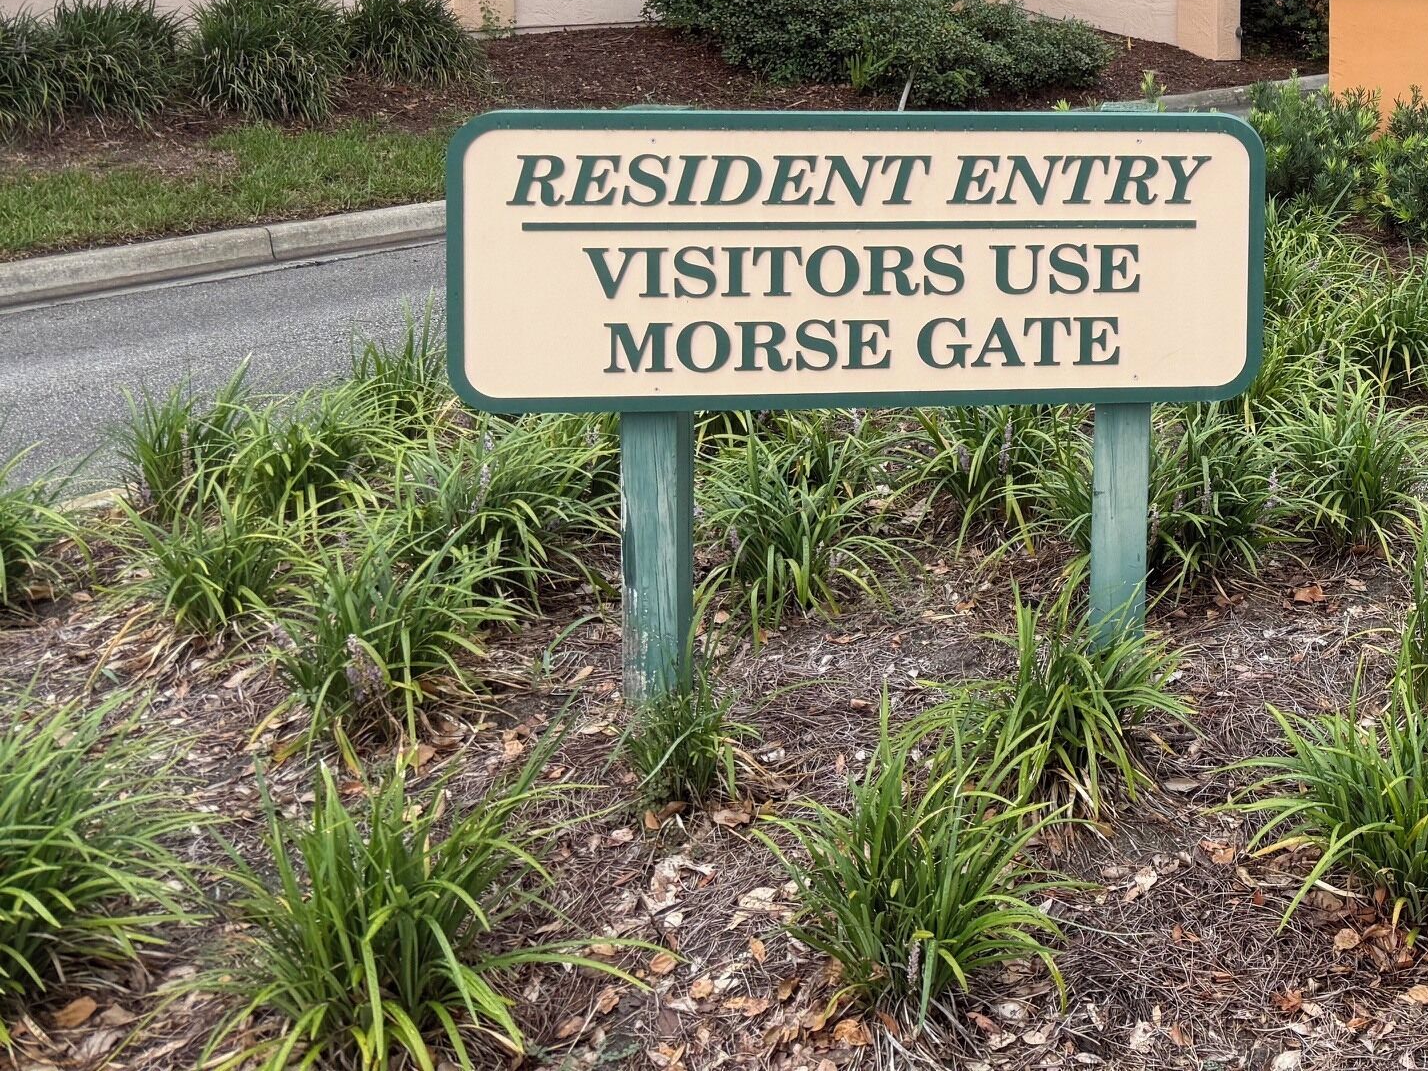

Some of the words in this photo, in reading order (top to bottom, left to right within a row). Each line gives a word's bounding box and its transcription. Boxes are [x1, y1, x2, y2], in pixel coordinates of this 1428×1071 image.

[505, 153, 932, 207] RESIDENT
[946, 155, 1212, 206] ENTRY
[582, 244, 965, 300] VISITORS
[988, 243, 1141, 295] USE
[603, 319, 892, 374] MORSE
[916, 316, 1121, 370] GATE
